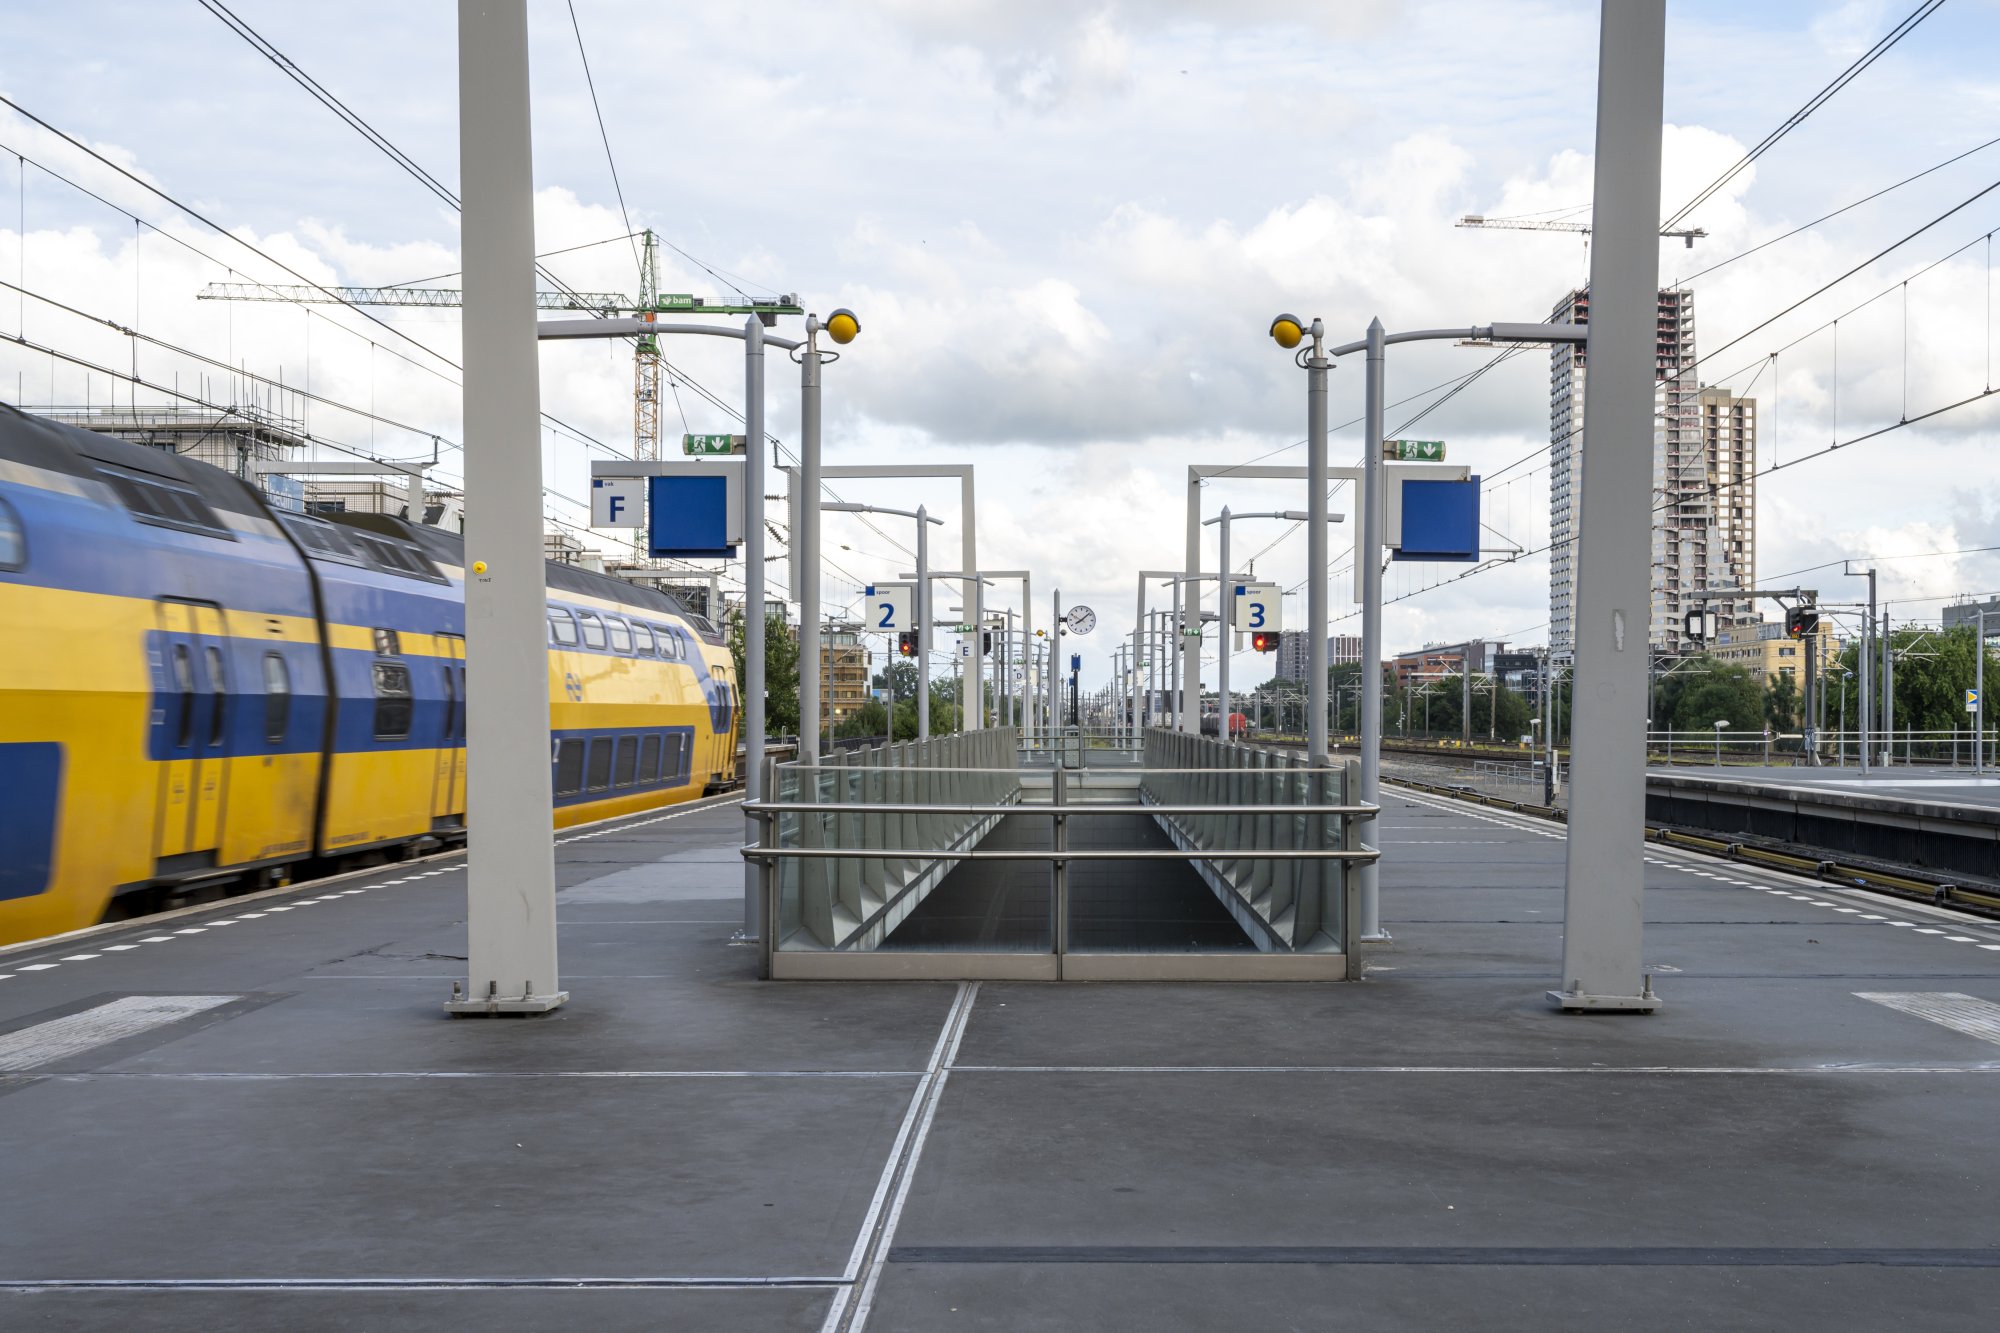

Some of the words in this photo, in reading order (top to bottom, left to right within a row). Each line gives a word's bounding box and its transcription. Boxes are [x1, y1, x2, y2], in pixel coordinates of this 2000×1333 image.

[672, 296, 692, 304] bam
[610, 496, 625, 522] F
[879, 603, 895, 628] 2
[1248, 602, 1265, 628] 3
[962, 646, 969, 656] E
[1016, 672, 1022, 680] D
